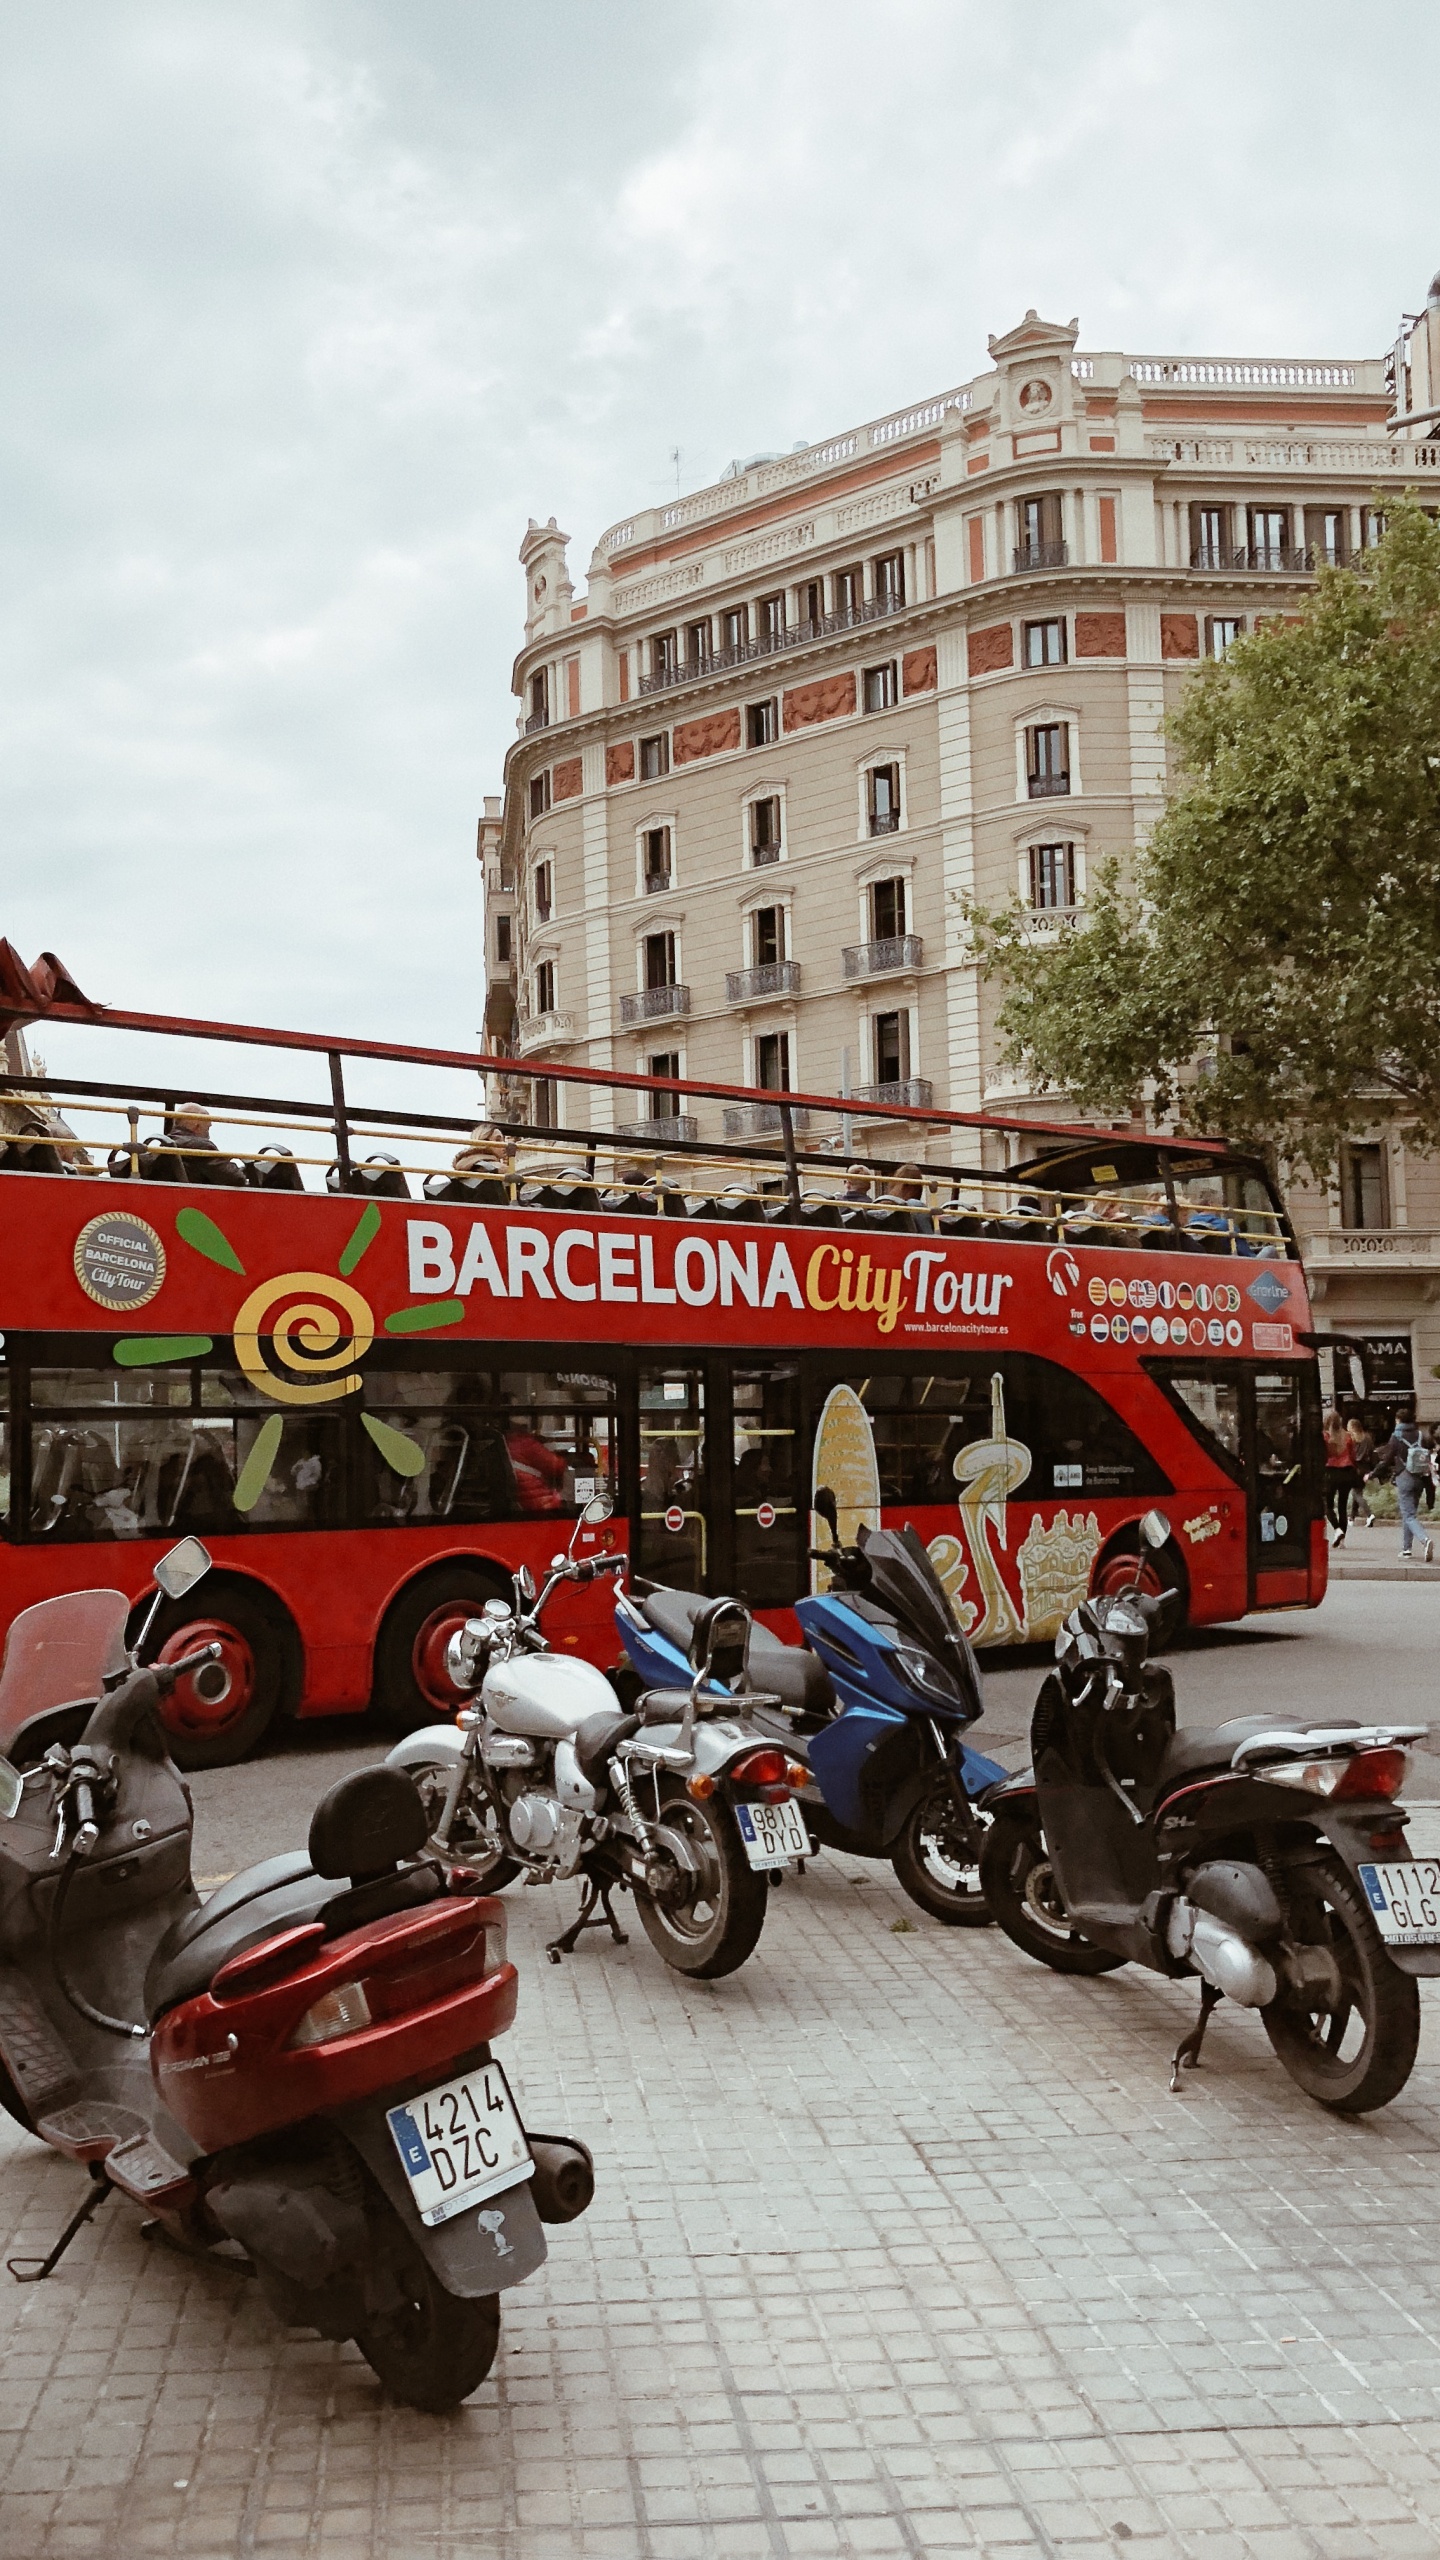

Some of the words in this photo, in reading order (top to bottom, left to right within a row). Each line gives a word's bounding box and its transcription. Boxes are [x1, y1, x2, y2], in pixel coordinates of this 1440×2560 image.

[97, 1233, 148, 1253] OFFICIAL
[85, 1249, 154, 1272] BARCELONA
[91, 1267, 117, 1288] City
[116, 1272, 145, 1290] Tour
[407, 1219, 805, 1309] BARCELONA
[806, 1244, 907, 1333] City
[904, 1250, 1013, 1316] Tour
[904, 1322, 1009, 1336] www.barcelonacitytour.es
[1336, 1342, 1407, 1355] OAMA
[753, 1804, 798, 1830] 9811
[745, 1826, 753, 1836] E
[762, 1827, 803, 1854] DYD
[1382, 1866, 1440, 1896] 1112
[1372, 1892, 1382, 1903] E
[1391, 1898, 1437, 1928] GLG
[424, 2074, 504, 2141] 4214
[408, 2146, 422, 2163] E
[430, 2127, 499, 2191] DZC
